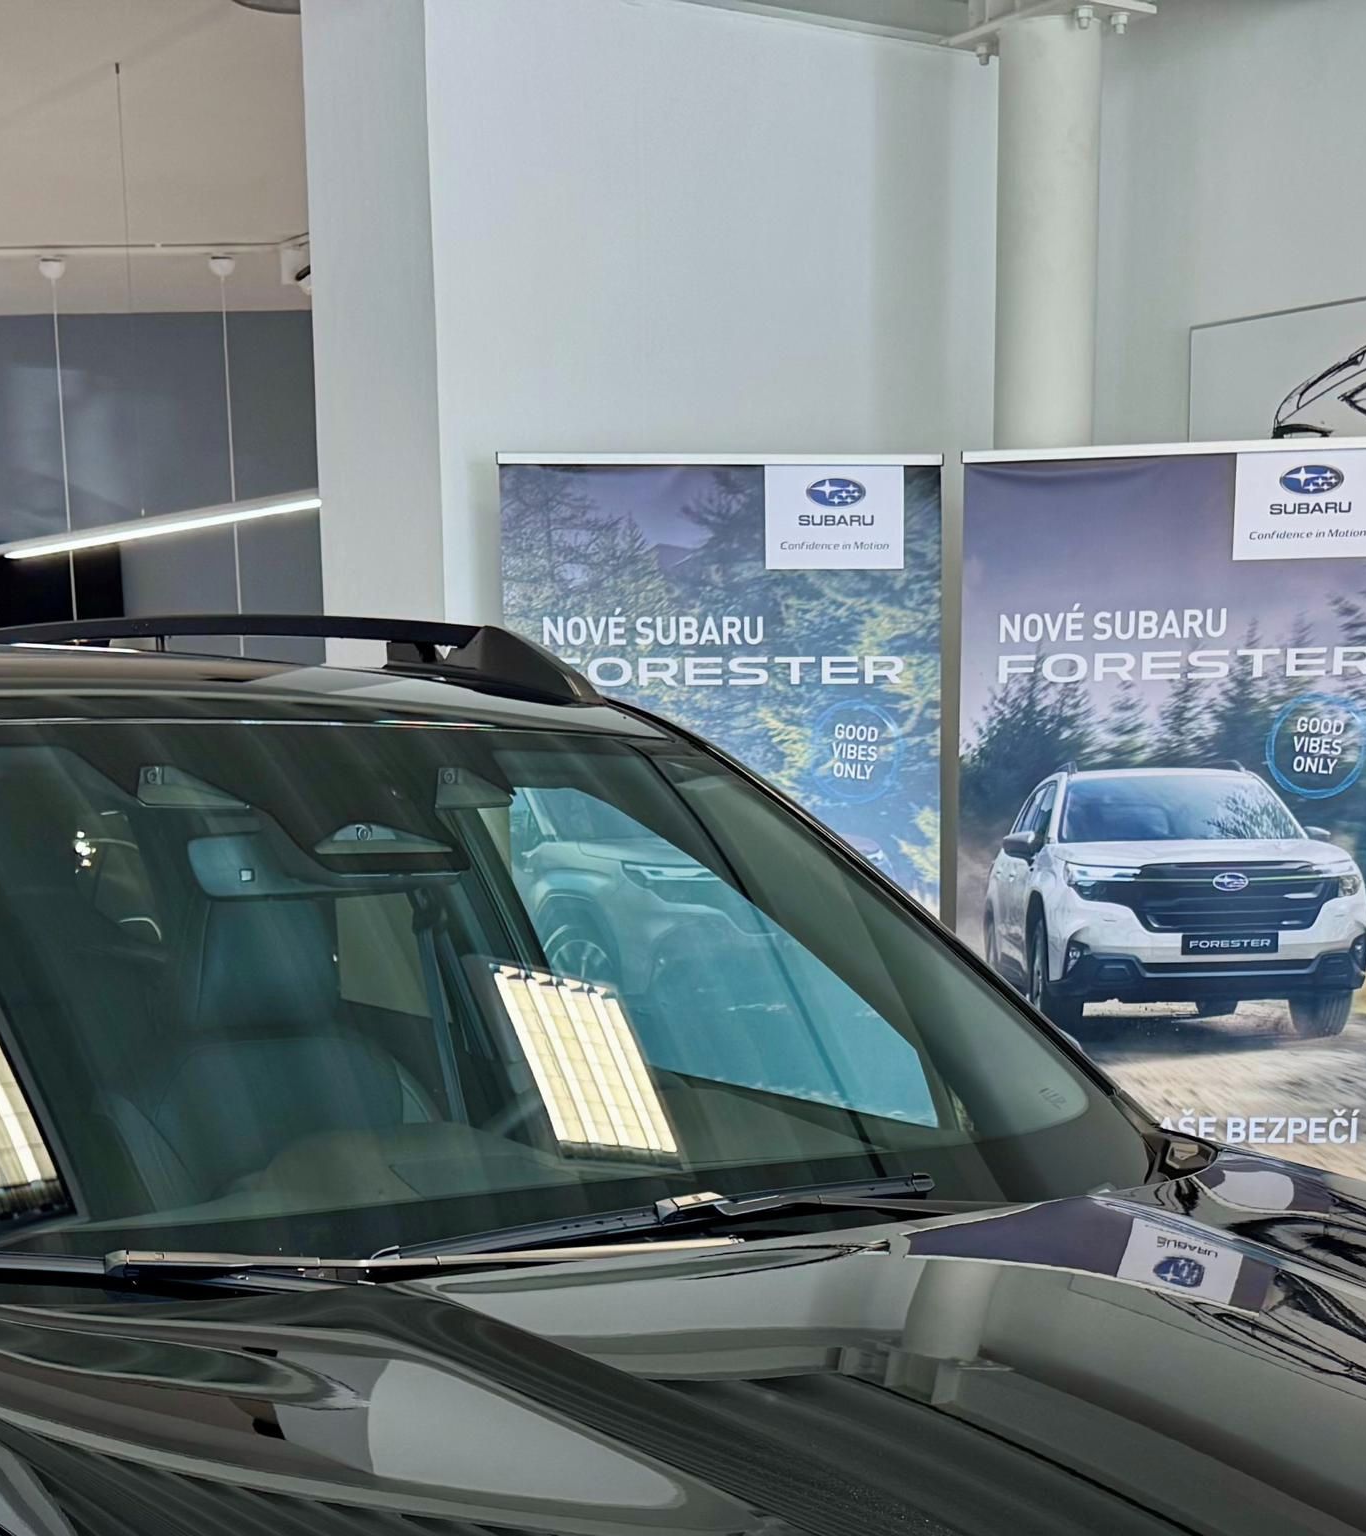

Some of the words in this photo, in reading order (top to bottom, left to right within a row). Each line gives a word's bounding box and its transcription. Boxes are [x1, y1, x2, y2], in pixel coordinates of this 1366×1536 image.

[1268, 500, 1353, 516] SUBARU
[797, 513, 875, 527] SUBARU
[1248, 529, 1313, 541] Confidence
[1314, 529, 1326, 540] in
[779, 540, 840, 552] Confidence
[841, 541, 852, 551] in
[853, 541, 890, 551] Motion
[542, 608, 627, 646] NOVÉ
[635, 615, 765, 646] SUBARU
[998, 603, 1085, 644] NOVÉ
[1091, 607, 1228, 640] SUBARU
[834, 723, 879, 743] GOOD
[1296, 716, 1345, 736] GOOD
[832, 742, 879, 762] VIBES
[1293, 735, 1343, 755] VIBES
[832, 761, 876, 780] ONLY
[1292, 755, 1338, 775] ONLY
[1188, 937, 1272, 949] FORESTER
[1226, 1108, 1361, 1145] BEZPEČÍ
